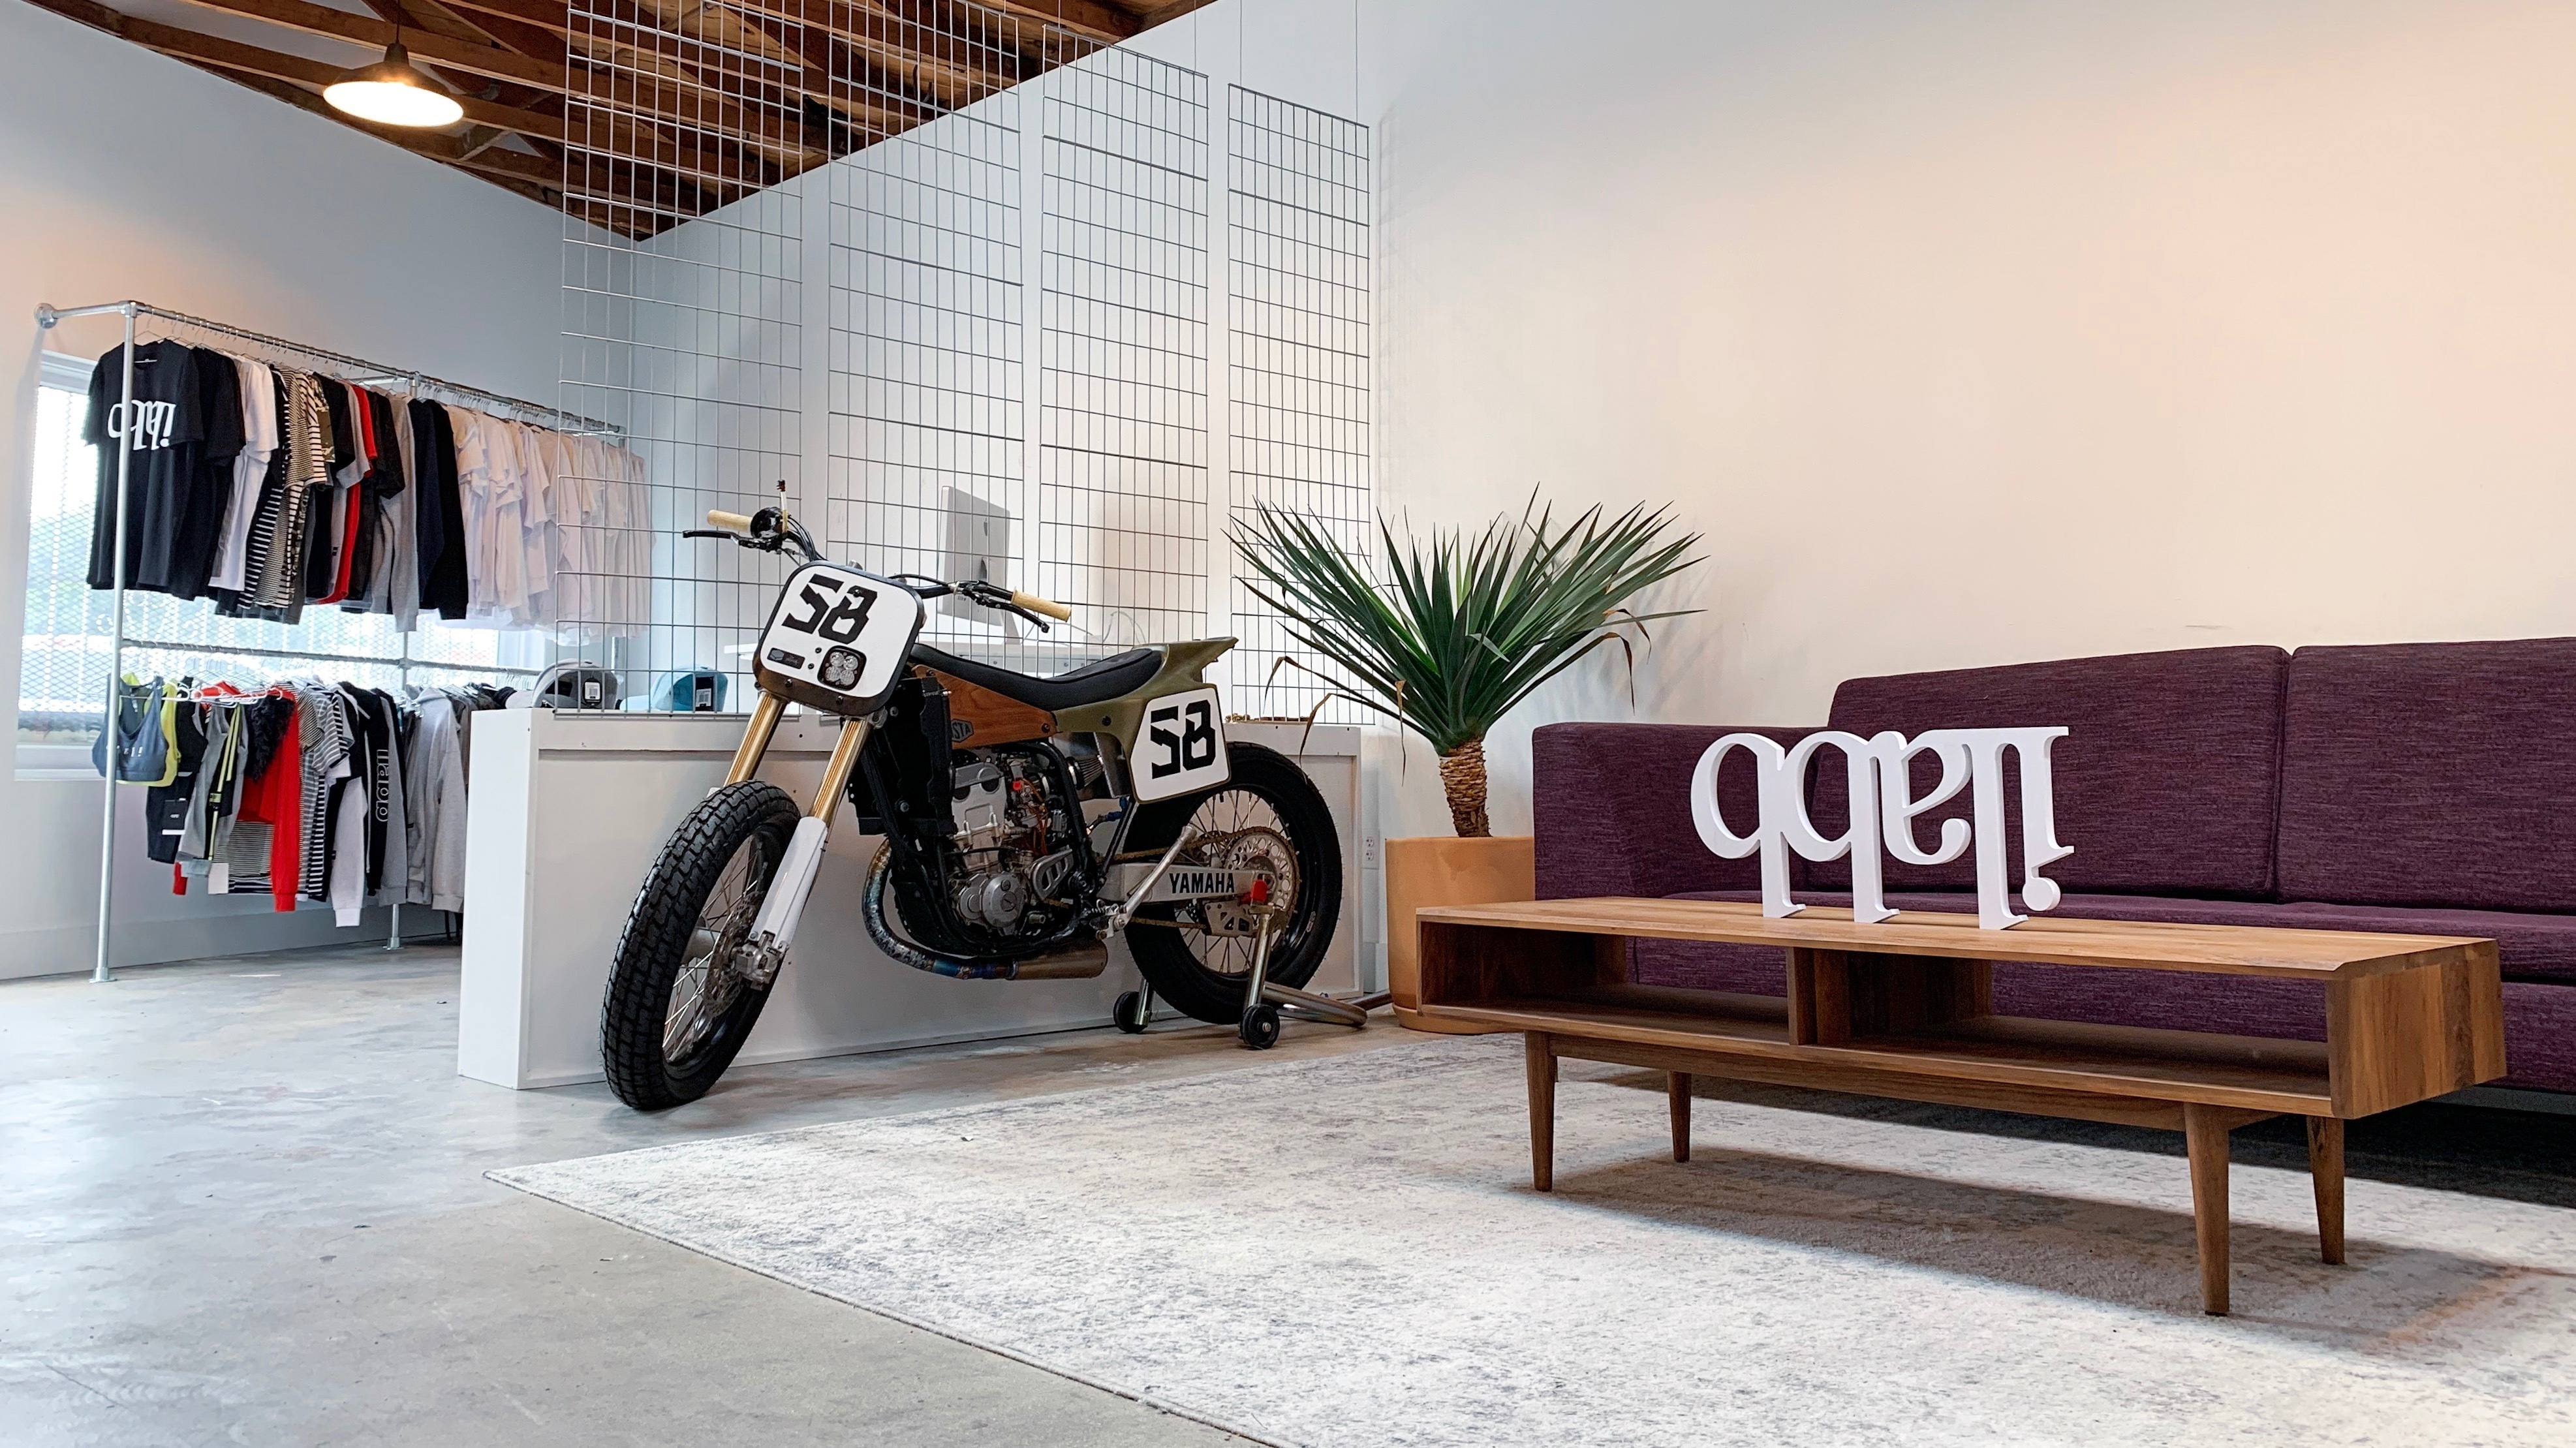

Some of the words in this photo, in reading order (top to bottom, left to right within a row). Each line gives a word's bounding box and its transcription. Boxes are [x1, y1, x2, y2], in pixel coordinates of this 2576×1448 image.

[782, 574, 878, 644] 58
[952, 722, 971, 739] STA
[1150, 700, 1217, 780] 58
[1690, 726, 2074, 930] ilabb
[1169, 872, 1235, 894] YAMAHA
